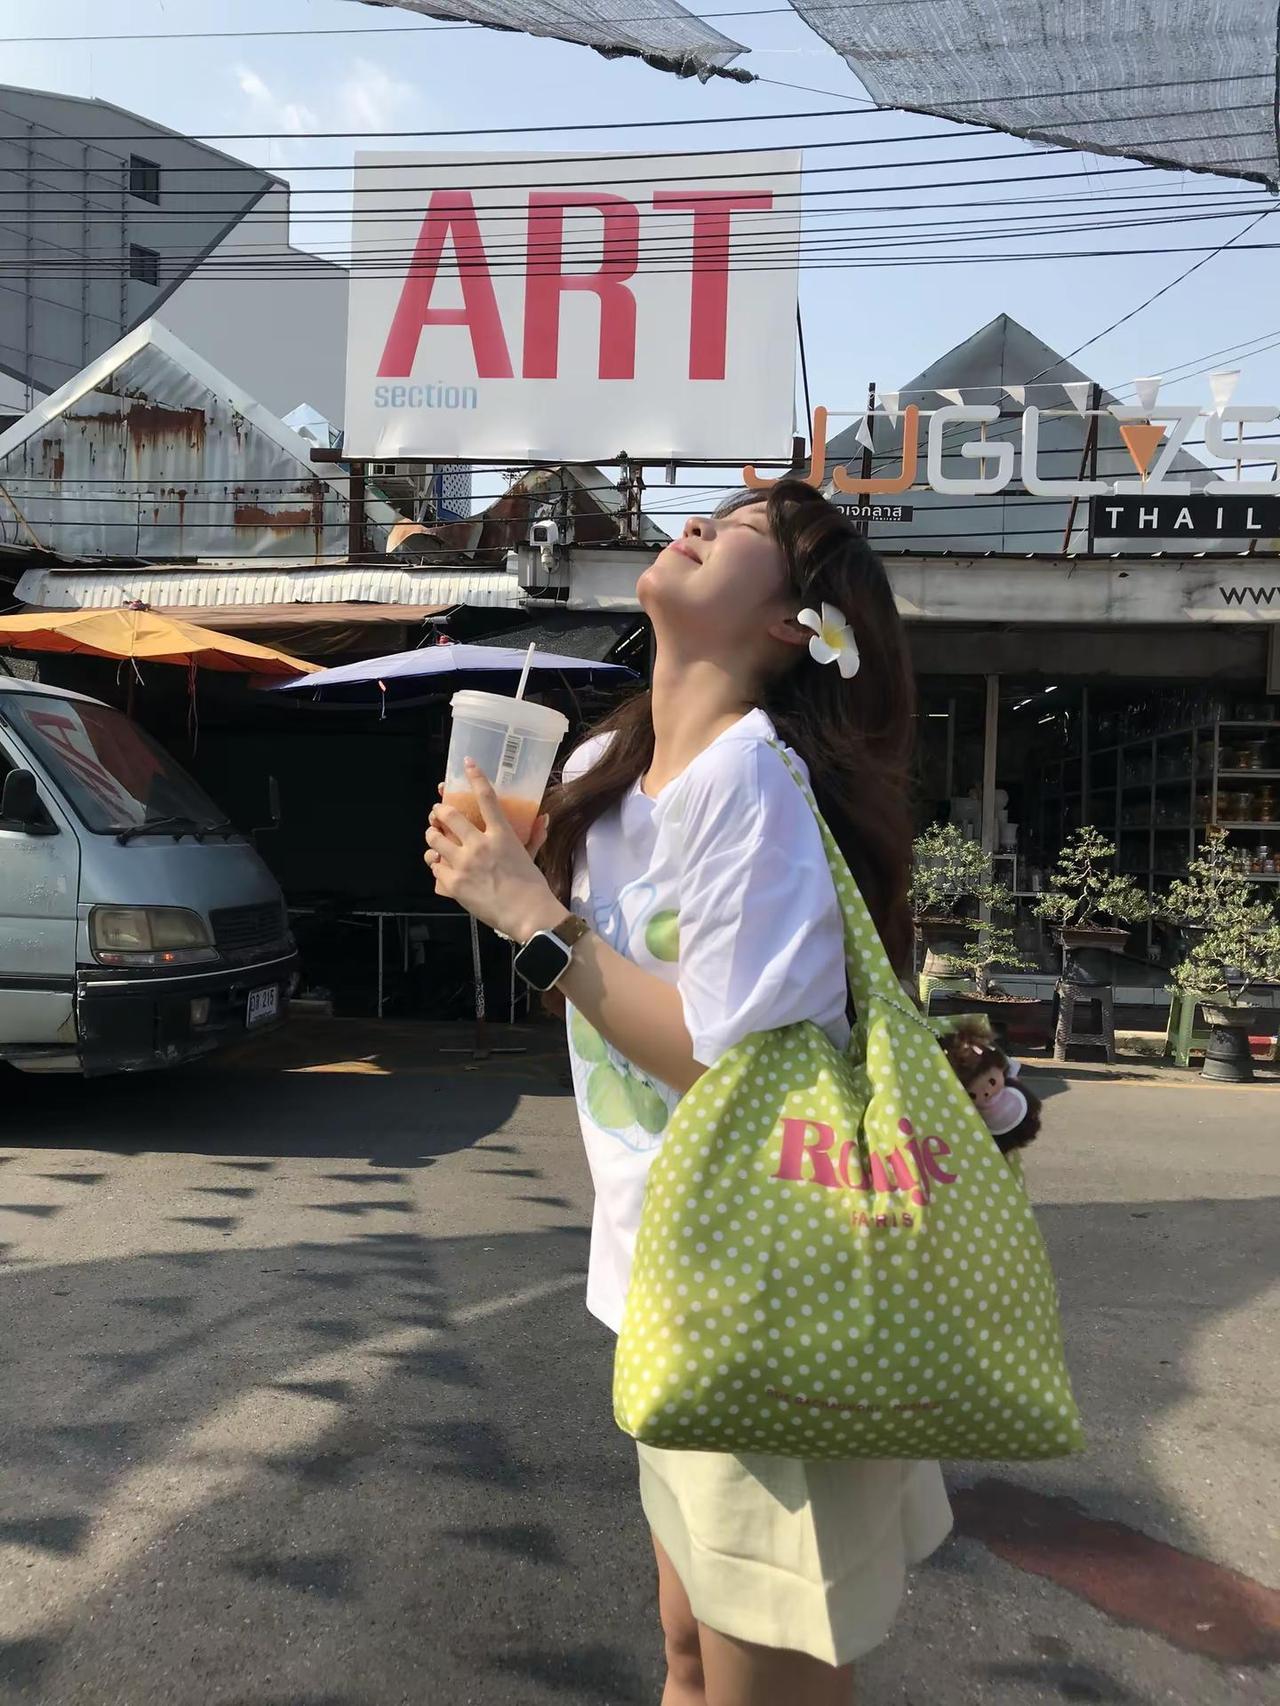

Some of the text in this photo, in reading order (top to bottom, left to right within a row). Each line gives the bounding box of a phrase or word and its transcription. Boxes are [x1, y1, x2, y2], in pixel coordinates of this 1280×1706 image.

[377, 190, 773, 380] ART
[375, 381, 477, 409] section
[771, 1117, 958, 1206] Rouje
